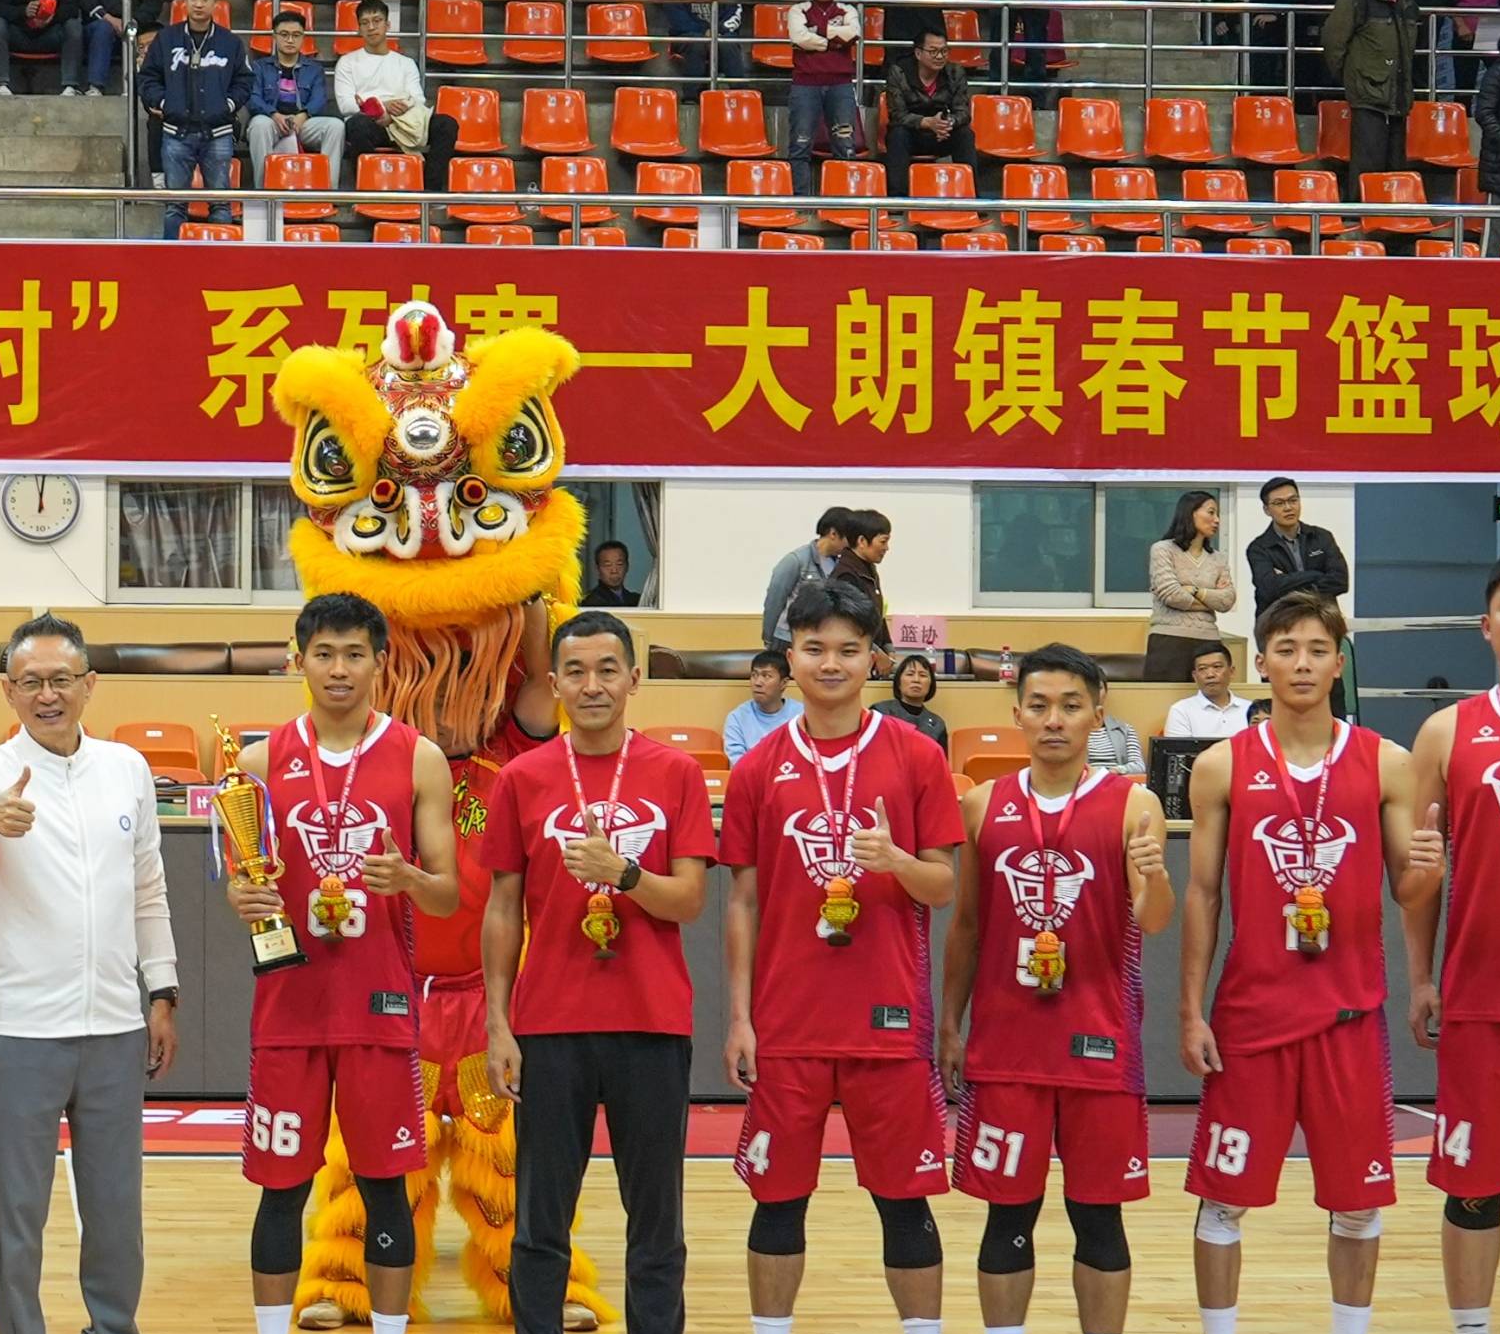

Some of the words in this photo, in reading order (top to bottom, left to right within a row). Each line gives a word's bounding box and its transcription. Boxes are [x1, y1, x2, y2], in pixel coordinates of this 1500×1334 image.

[35, 524, 47, 533] 10
[900, 624, 938, 644] 篮协
[253, 1107, 301, 1158] 66
[746, 1130, 772, 1176] 4
[971, 1123, 1026, 1179] 51
[1205, 1121, 1251, 1177] 13
[1439, 1114, 1473, 1168] 14
